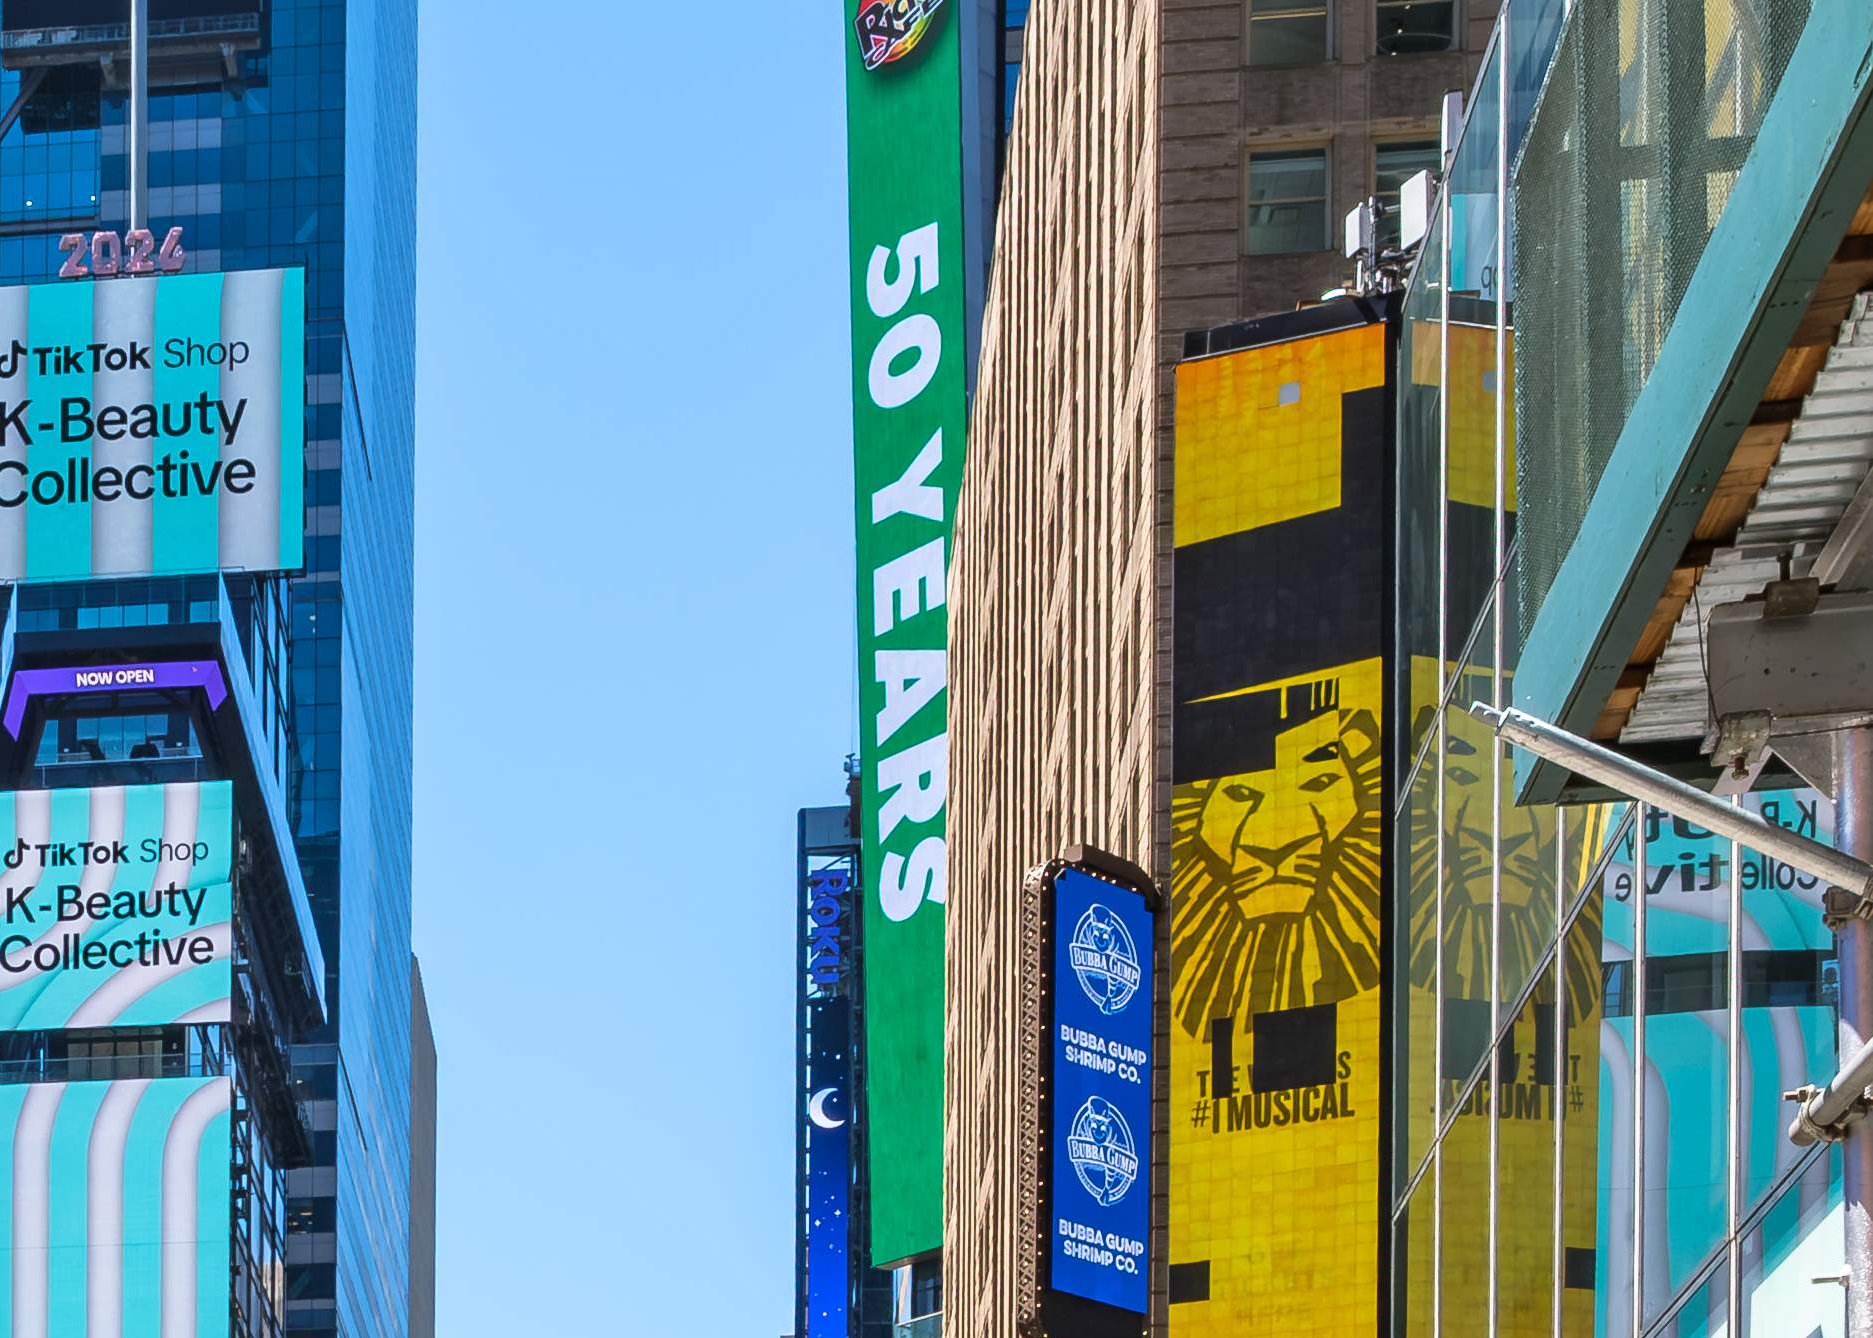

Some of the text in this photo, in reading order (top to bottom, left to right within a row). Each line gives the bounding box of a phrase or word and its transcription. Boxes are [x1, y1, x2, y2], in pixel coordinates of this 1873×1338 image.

[33, 337, 250, 377] TikTok Shop
[866, 222, 948, 922] 50 YEARS
[76, 669, 155, 688] NOW OPEN
[35, 837, 210, 867] TikTok Shop
[5, 883, 208, 925] K-Beauty
[811, 869, 849, 984] ROKU
[1073, 945, 1139, 986] BUBBA GUMP
[1060, 1024, 1147, 1065] BUBBA GUMP
[1064, 1045, 1142, 1085] SHRIMP CO.
[1227, 1082, 1355, 1133] MUSICAL
[1072, 1138, 1137, 1175] BUBBA GUMP
[1059, 1218, 1145, 1258] BUBBA GUMP
[1063, 1239, 1140, 1275] SHRIMP CO.
